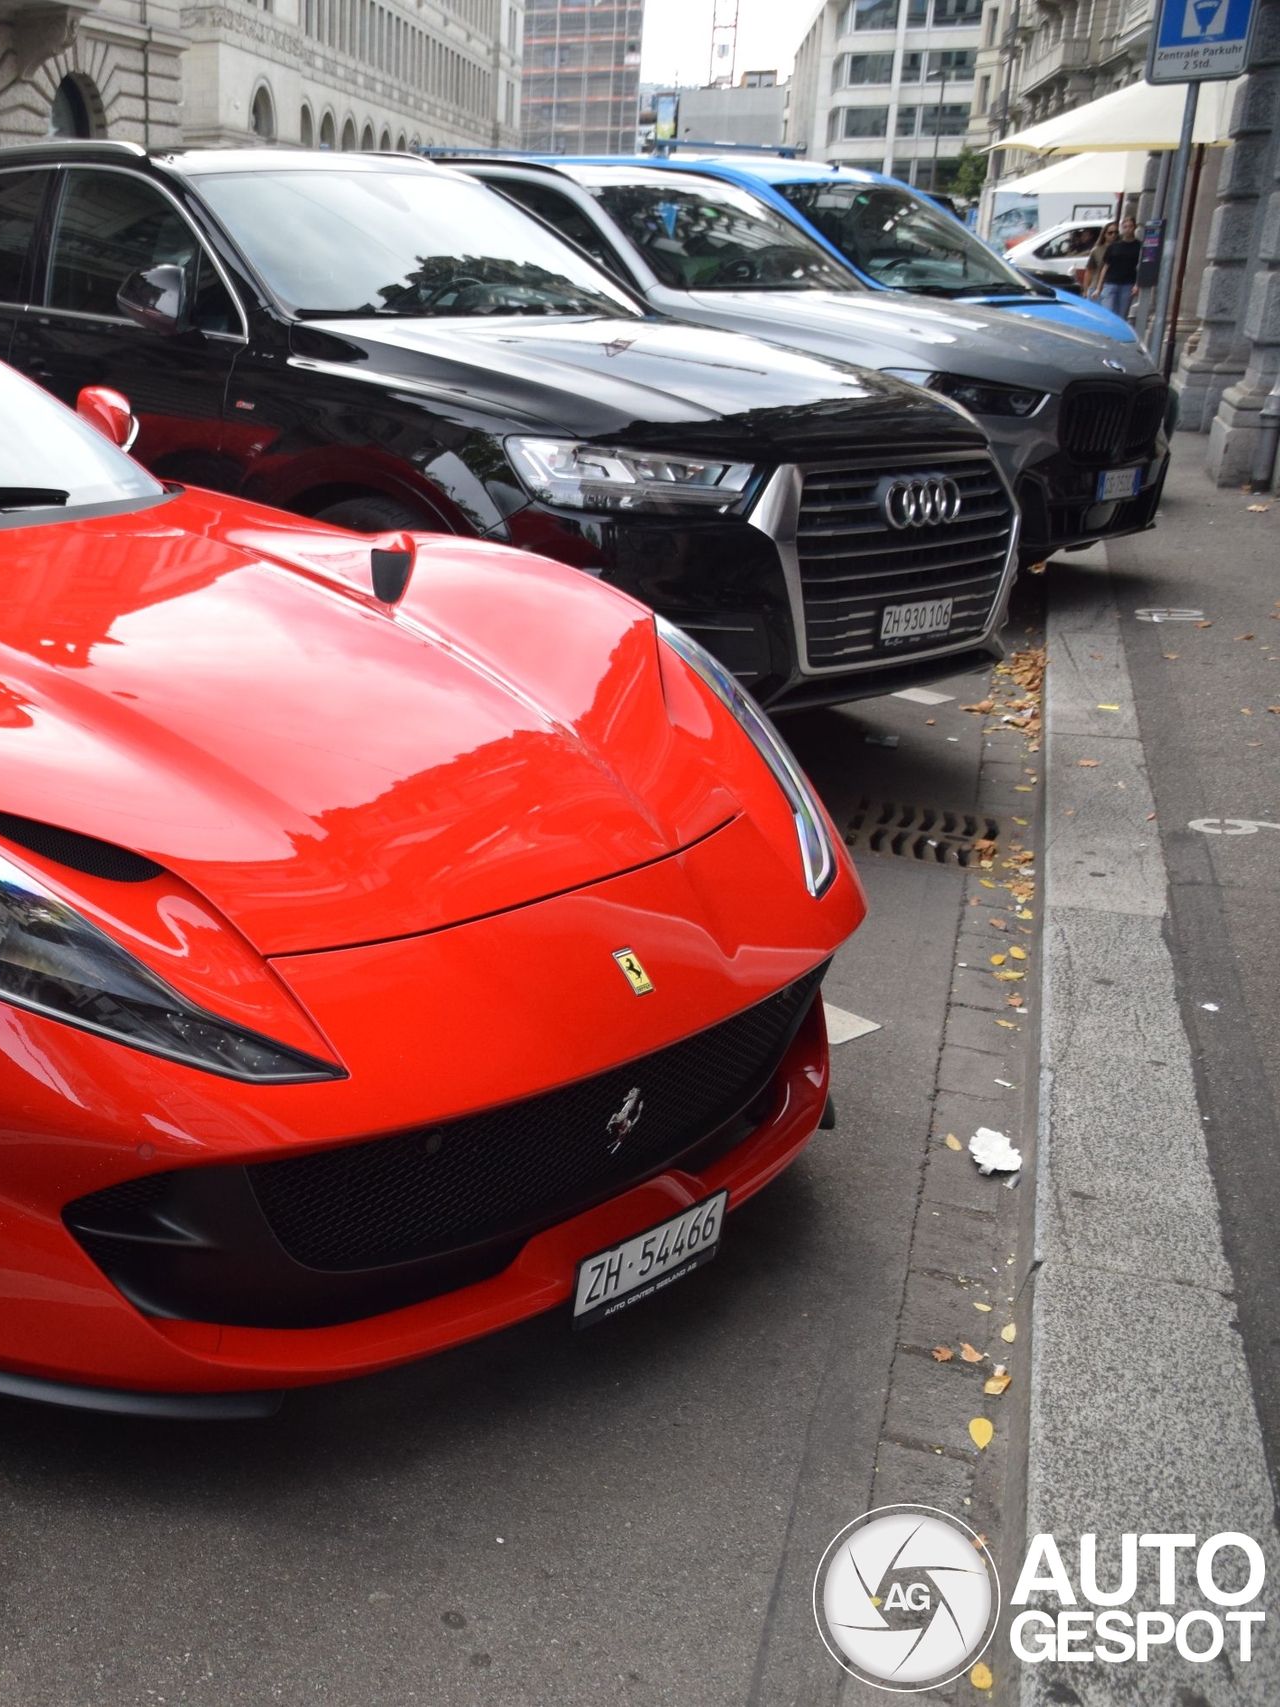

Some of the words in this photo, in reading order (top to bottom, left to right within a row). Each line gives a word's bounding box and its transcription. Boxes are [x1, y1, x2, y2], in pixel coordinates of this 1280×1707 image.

[1157, 49, 1200, 62] Zentrale
[1202, 44, 1243, 57] Parkuhr
[1182, 60, 1190, 70] 2
[1192, 59, 1213, 70] Std.
[604, 1301, 626, 1316] AUTO
[627, 1285, 655, 1305] CENTER
